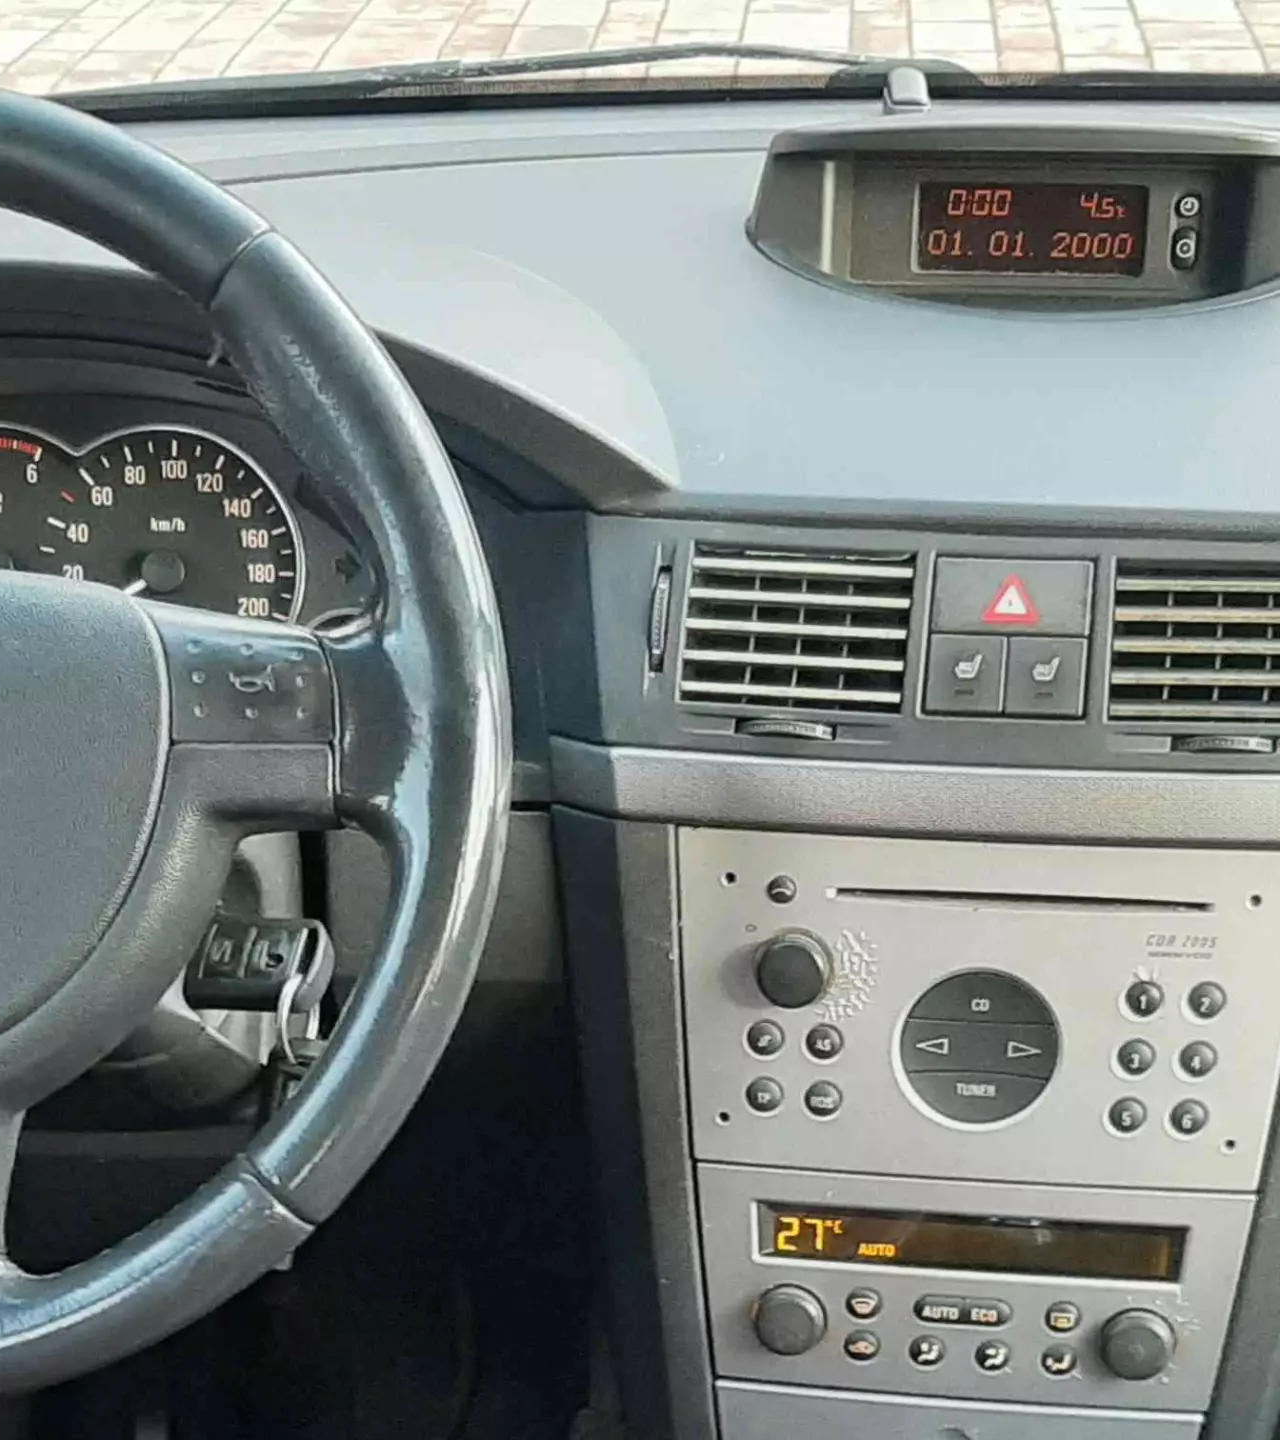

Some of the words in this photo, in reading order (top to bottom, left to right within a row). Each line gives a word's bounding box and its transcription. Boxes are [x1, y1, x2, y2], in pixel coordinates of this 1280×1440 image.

[1050, 232, 1134, 259] 2000
[26, 463, 38, 484] 6
[124, 465, 146, 485] 80
[161, 460, 187, 479] 100
[196, 473, 223, 493] 120
[91, 486, 113, 506] 60
[222, 499, 251, 518] 140
[66, 523, 89, 543] 40
[150, 517, 186, 532] km/h
[240, 529, 268, 548] 160
[248, 564, 276, 583] 180
[238, 597, 269, 617] 200
[1139, 995, 1147, 1010] 1
[1199, 997, 1210, 1013] 2
[1129, 1053, 1140, 1069] 3
[1121, 1110, 1132, 1127] 5
[1181, 1113, 1192, 1129] 6
[857, 1242, 896, 1258] AUTO
[921, 1306, 959, 1320] AUTO
[971, 1309, 998, 1322] ECO
